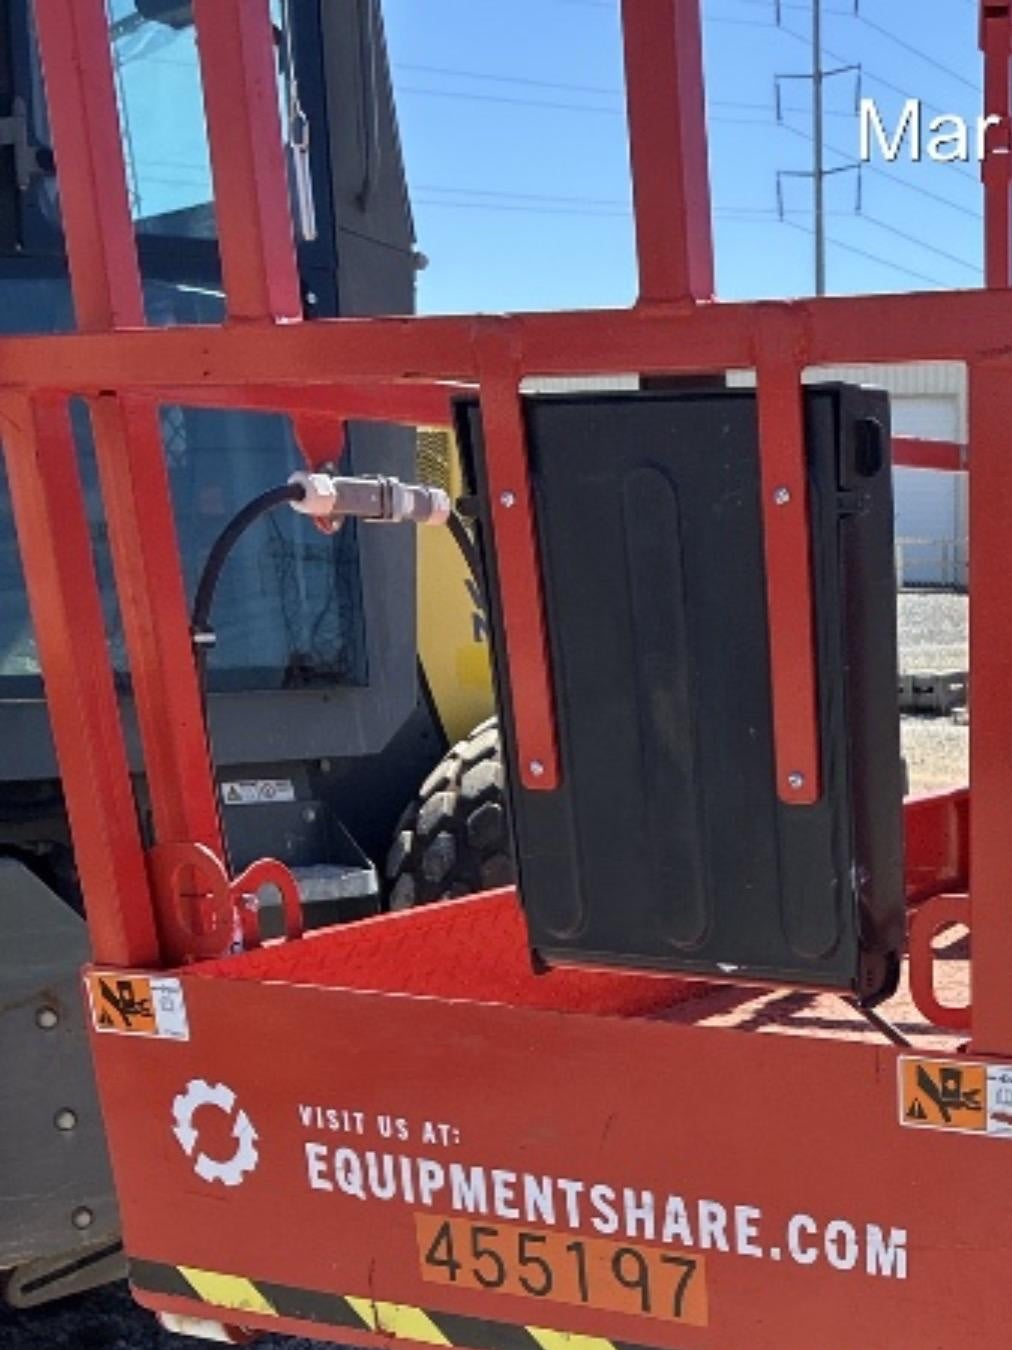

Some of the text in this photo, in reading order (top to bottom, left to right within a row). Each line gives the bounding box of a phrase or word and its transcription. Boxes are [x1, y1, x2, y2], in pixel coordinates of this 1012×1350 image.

[299, 1104, 460, 1146] VISIT US AT:
[305, 1142, 908, 1279] EQUIPMENTSHARE.COM
[424, 1220, 698, 1318] 455197
